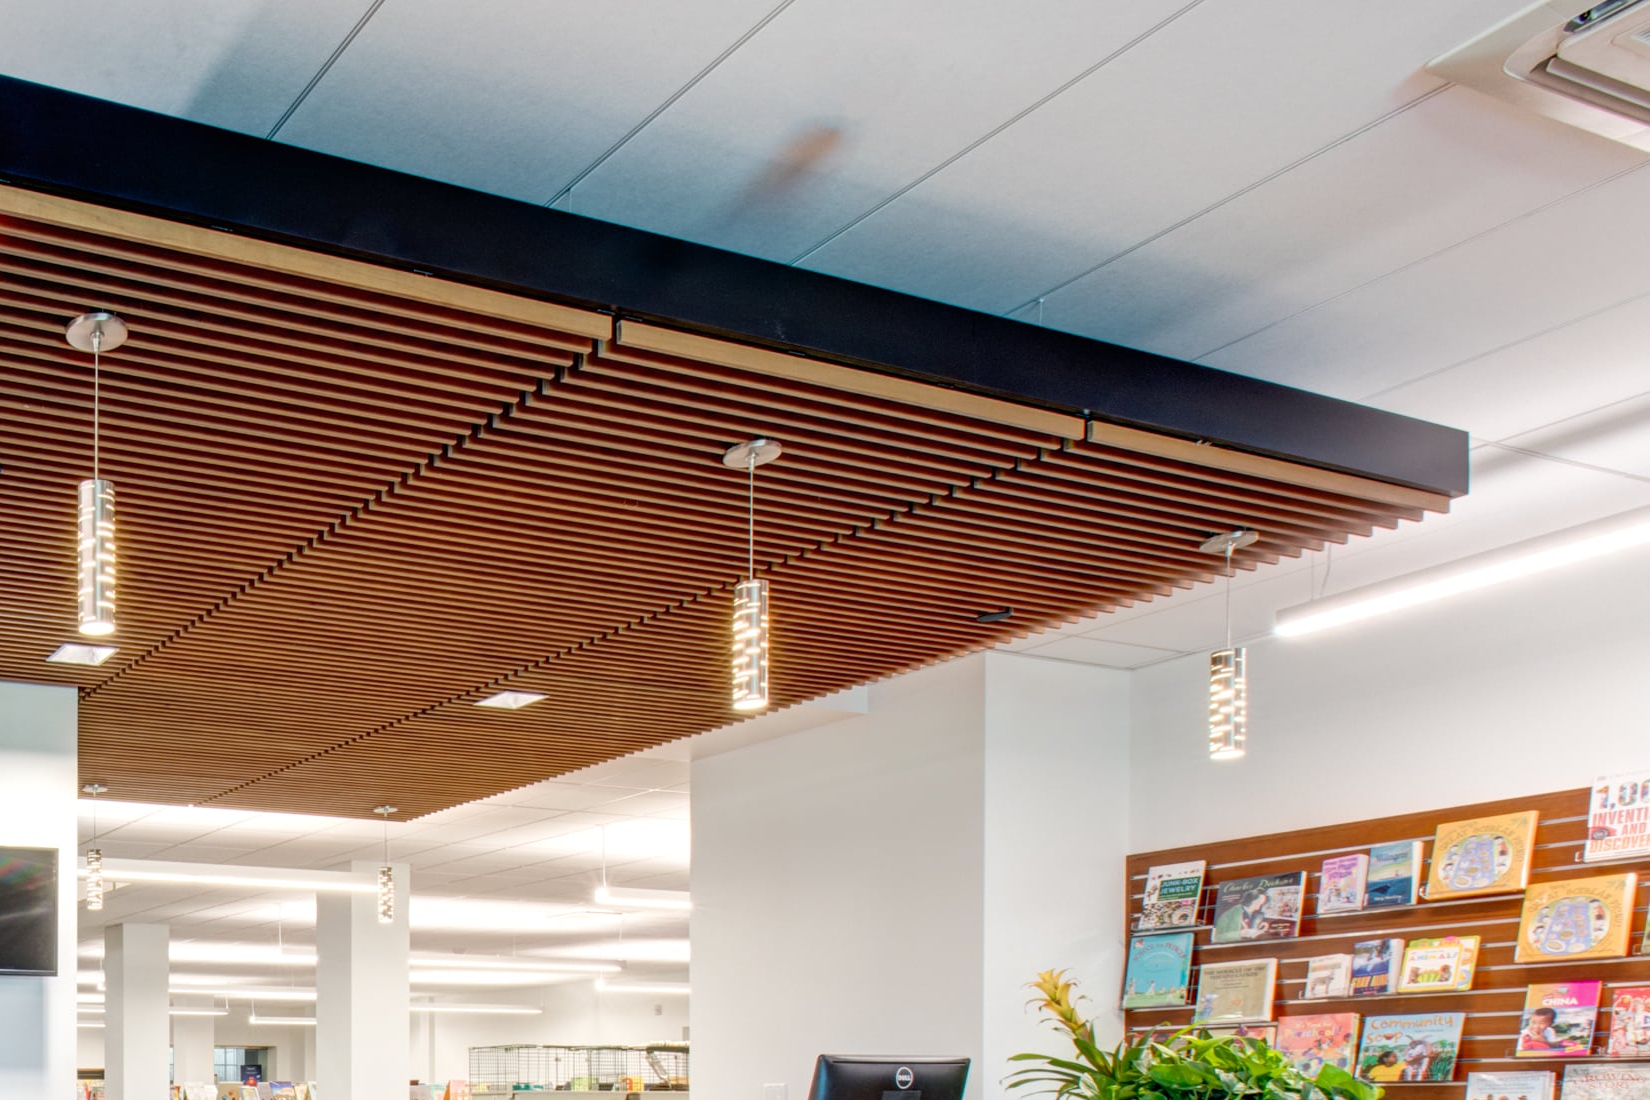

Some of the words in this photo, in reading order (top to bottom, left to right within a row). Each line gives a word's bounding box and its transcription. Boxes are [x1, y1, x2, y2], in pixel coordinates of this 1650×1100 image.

[1622, 822, 1647, 836] AND
[1542, 997, 1579, 1006] CHINA
[1370, 1015, 1454, 1031] Community
